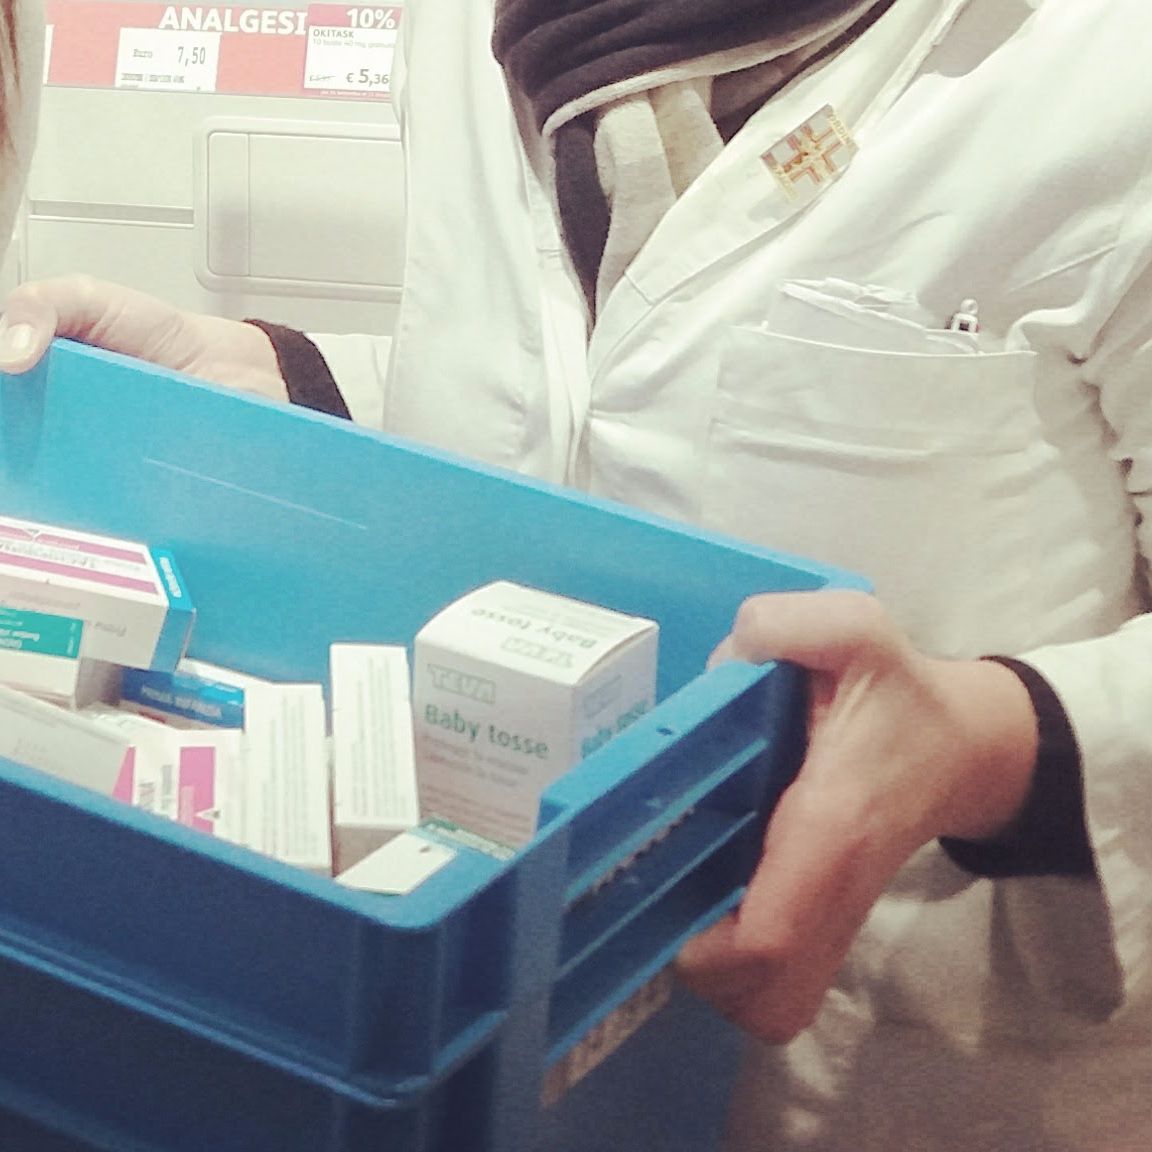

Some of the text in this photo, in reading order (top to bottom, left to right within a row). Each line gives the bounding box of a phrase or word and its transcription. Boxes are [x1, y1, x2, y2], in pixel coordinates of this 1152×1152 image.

[158, 6, 308, 36] ANALGESI
[346, 8, 397, 29] 10%
[312, 29, 355, 39] OKITASK
[133, 46, 206, 67] Euro 7,50
[346, 72, 354, 83] €
[358, 68, 389, 87] 5,36
[423, 703, 480, 743] Baby
[488, 724, 549, 759] tosse
